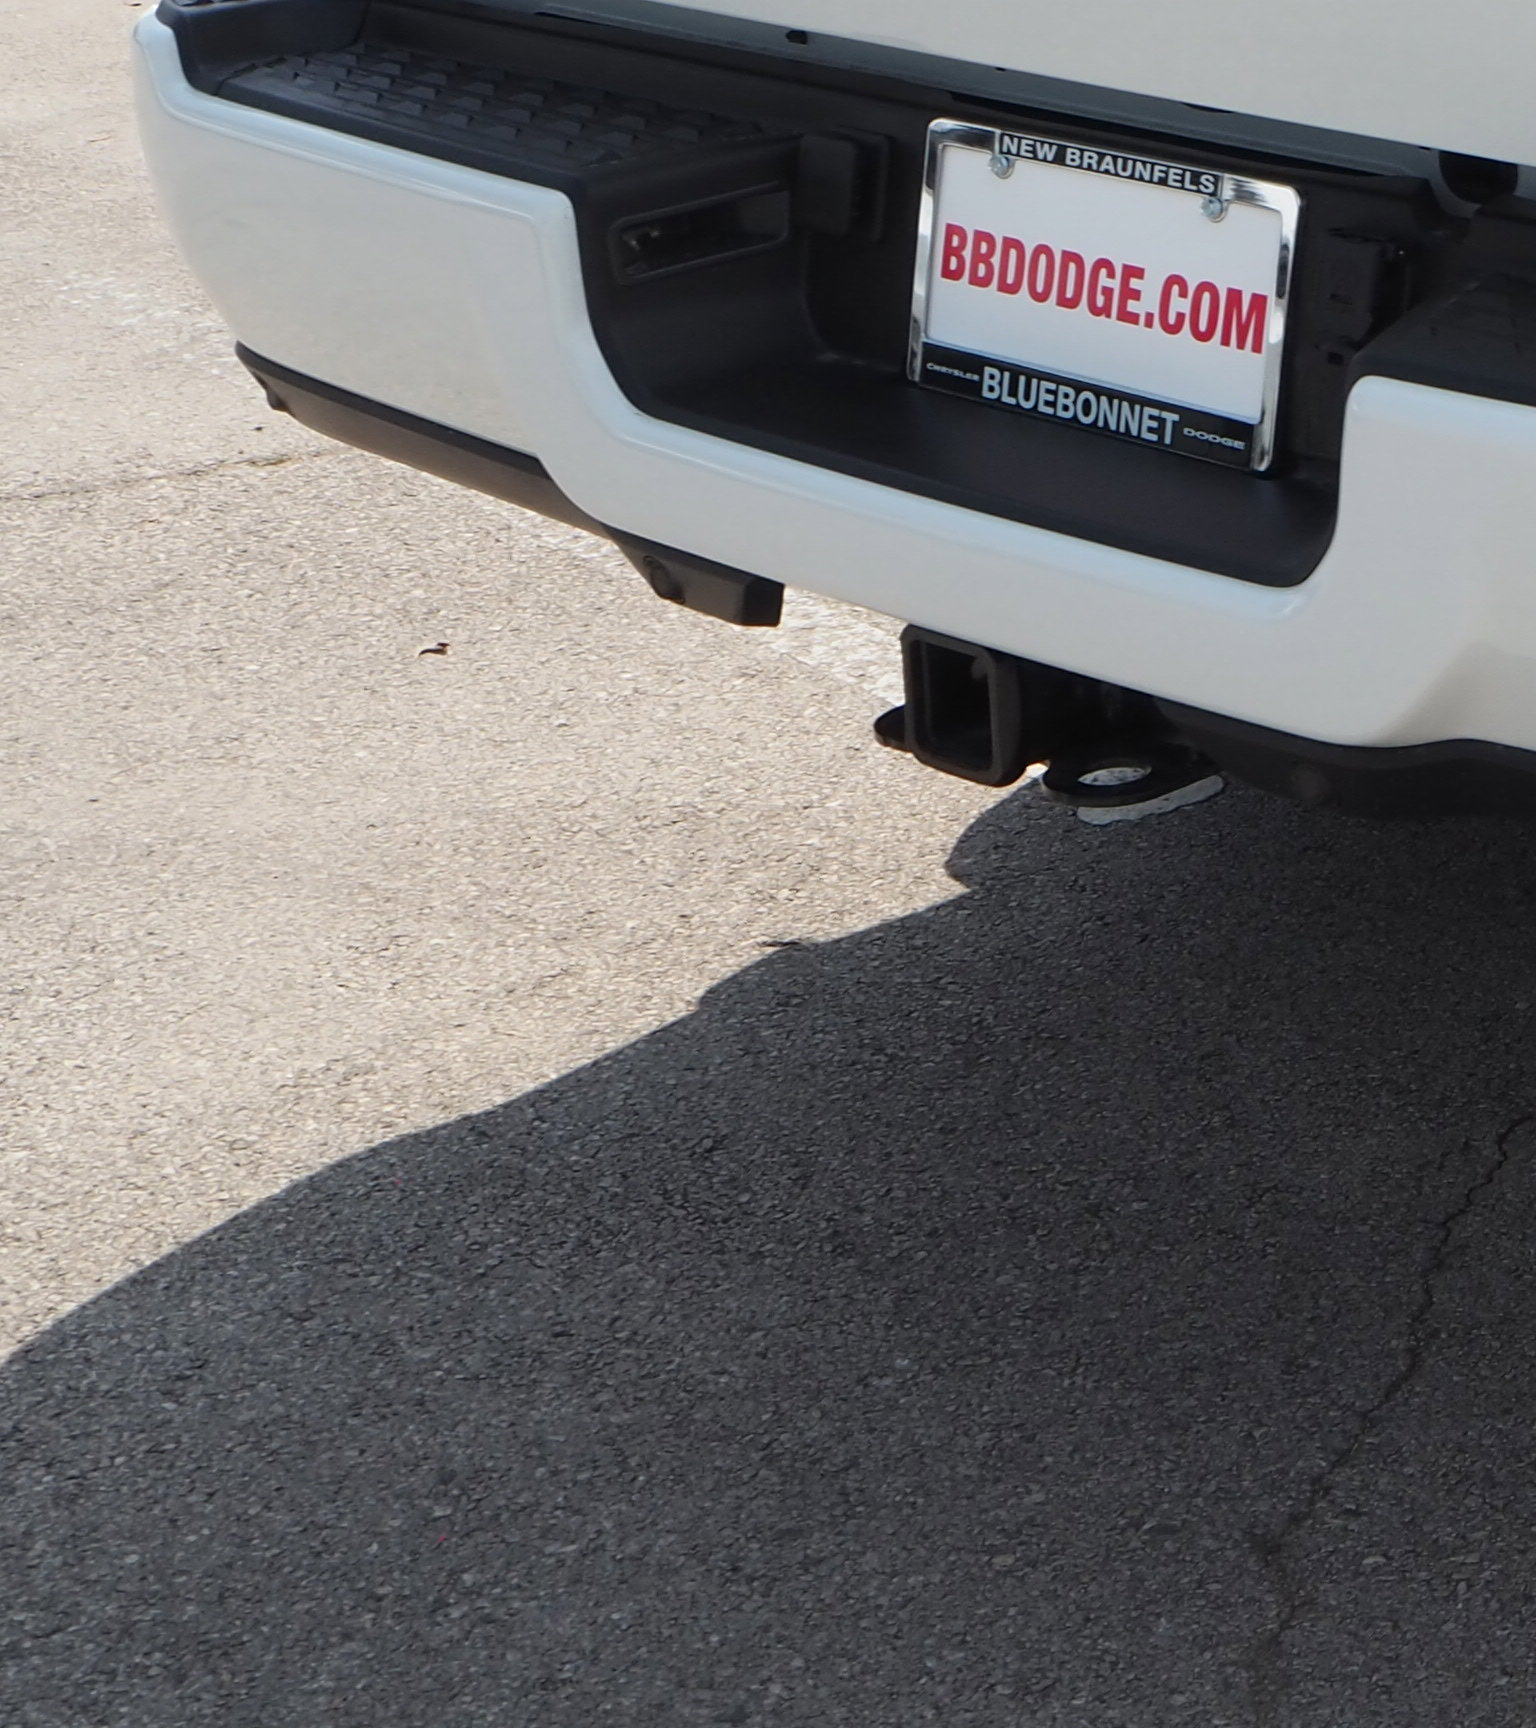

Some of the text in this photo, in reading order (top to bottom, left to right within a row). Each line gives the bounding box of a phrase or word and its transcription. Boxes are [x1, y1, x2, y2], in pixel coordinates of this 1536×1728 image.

[1002, 135, 1216, 194] NEW BRAUNFELS
[940, 222, 1269, 355] BBDODGE.COM
[926, 362, 1246, 450] CHRYSLER BLUEBONNET DODGE
